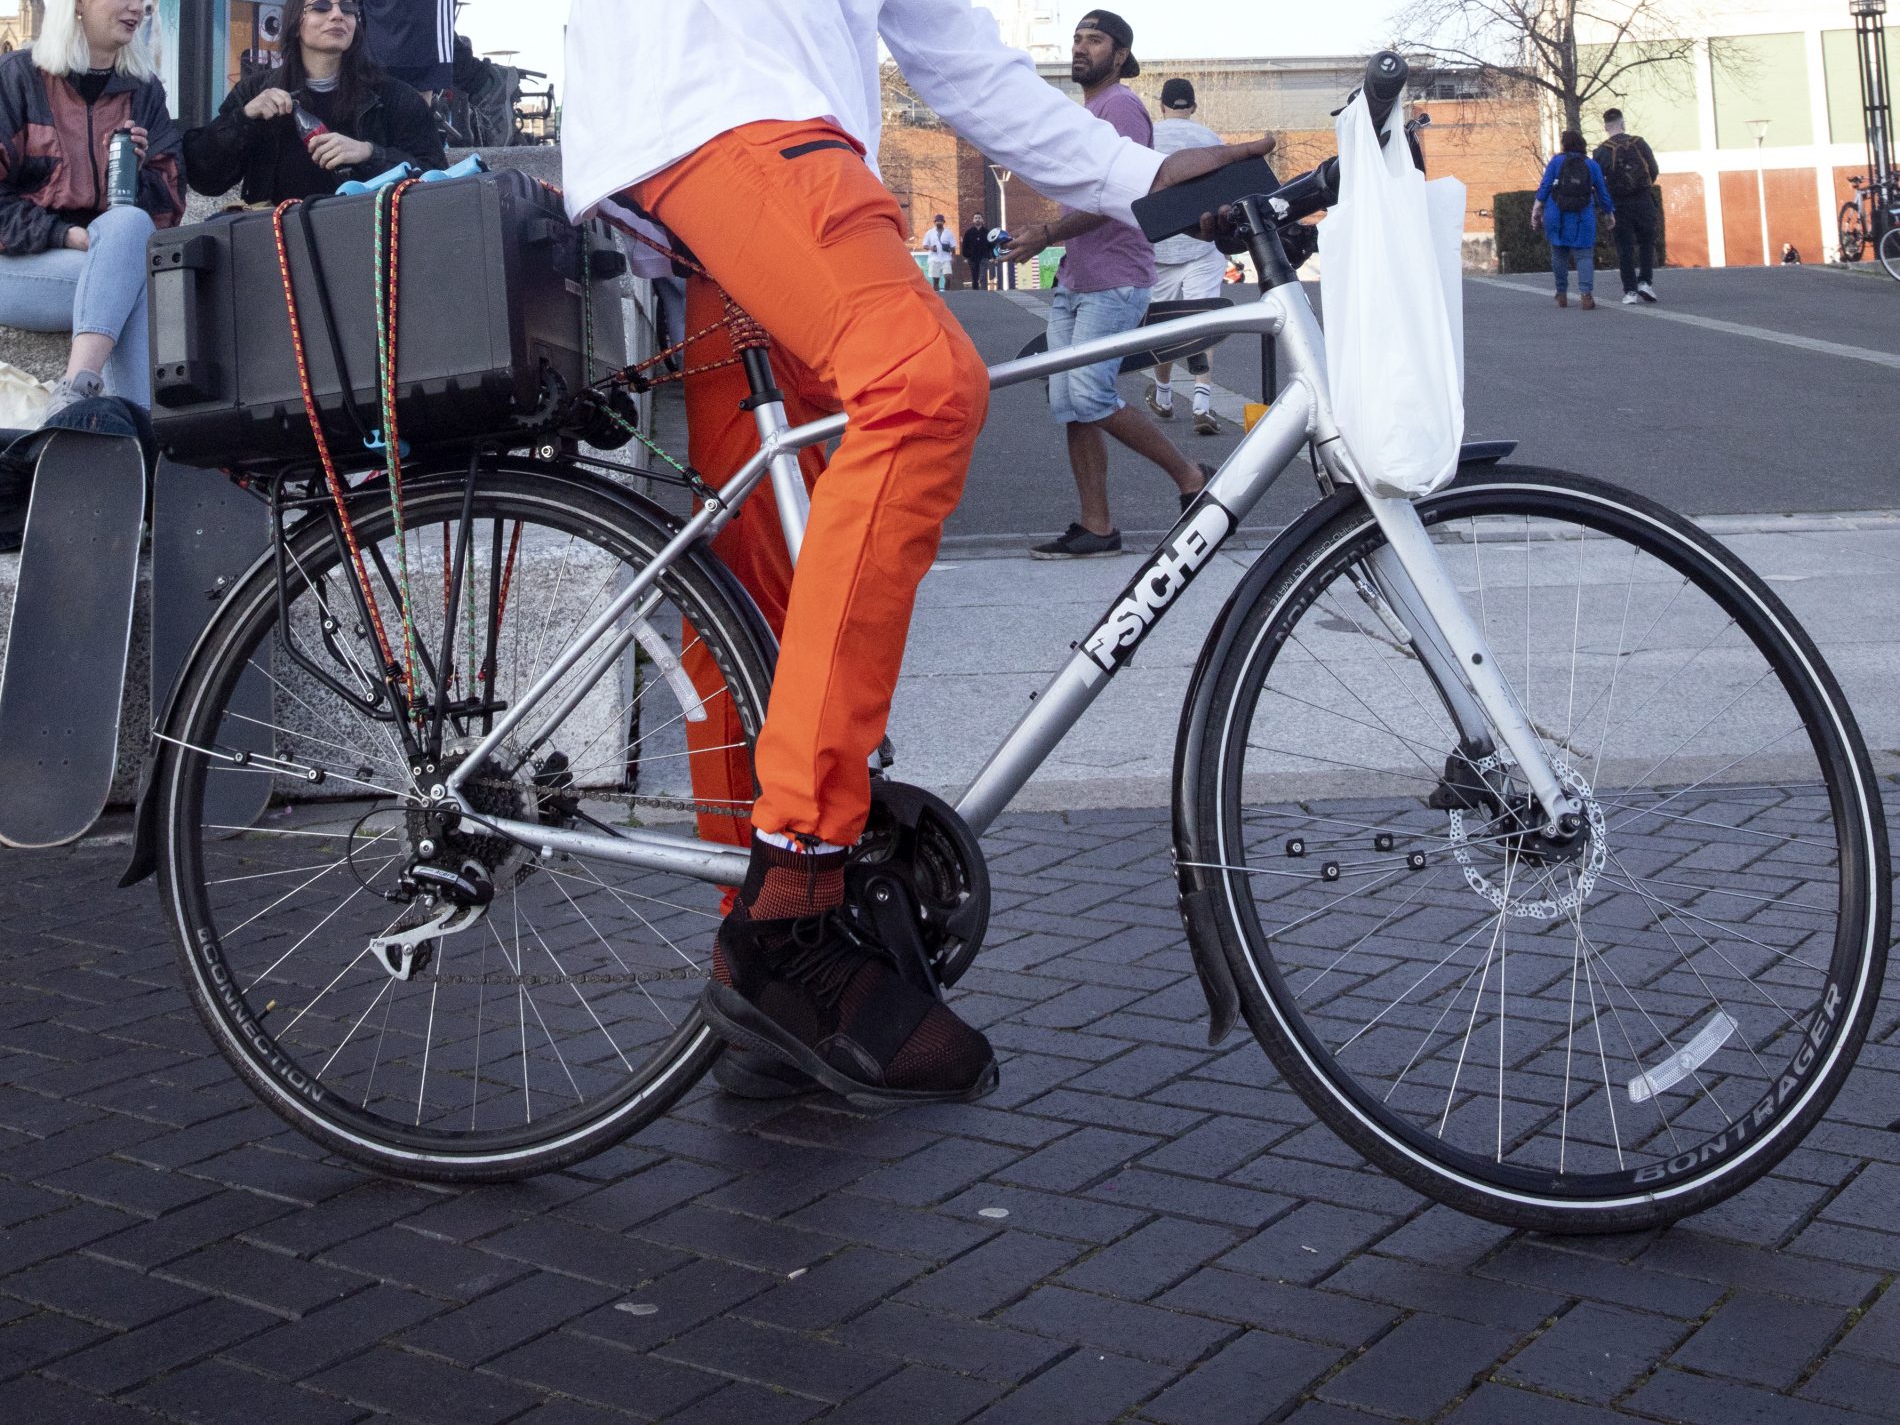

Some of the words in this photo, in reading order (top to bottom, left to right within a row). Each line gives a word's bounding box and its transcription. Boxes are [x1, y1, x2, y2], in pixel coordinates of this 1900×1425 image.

[1270, 561, 1309, 606] ULTIMATE
[1306, 520, 1360, 563] HARD-CASE
[203, 944, 325, 1103] CONNECTION
[1634, 982, 1842, 1184] BONTRAGER
